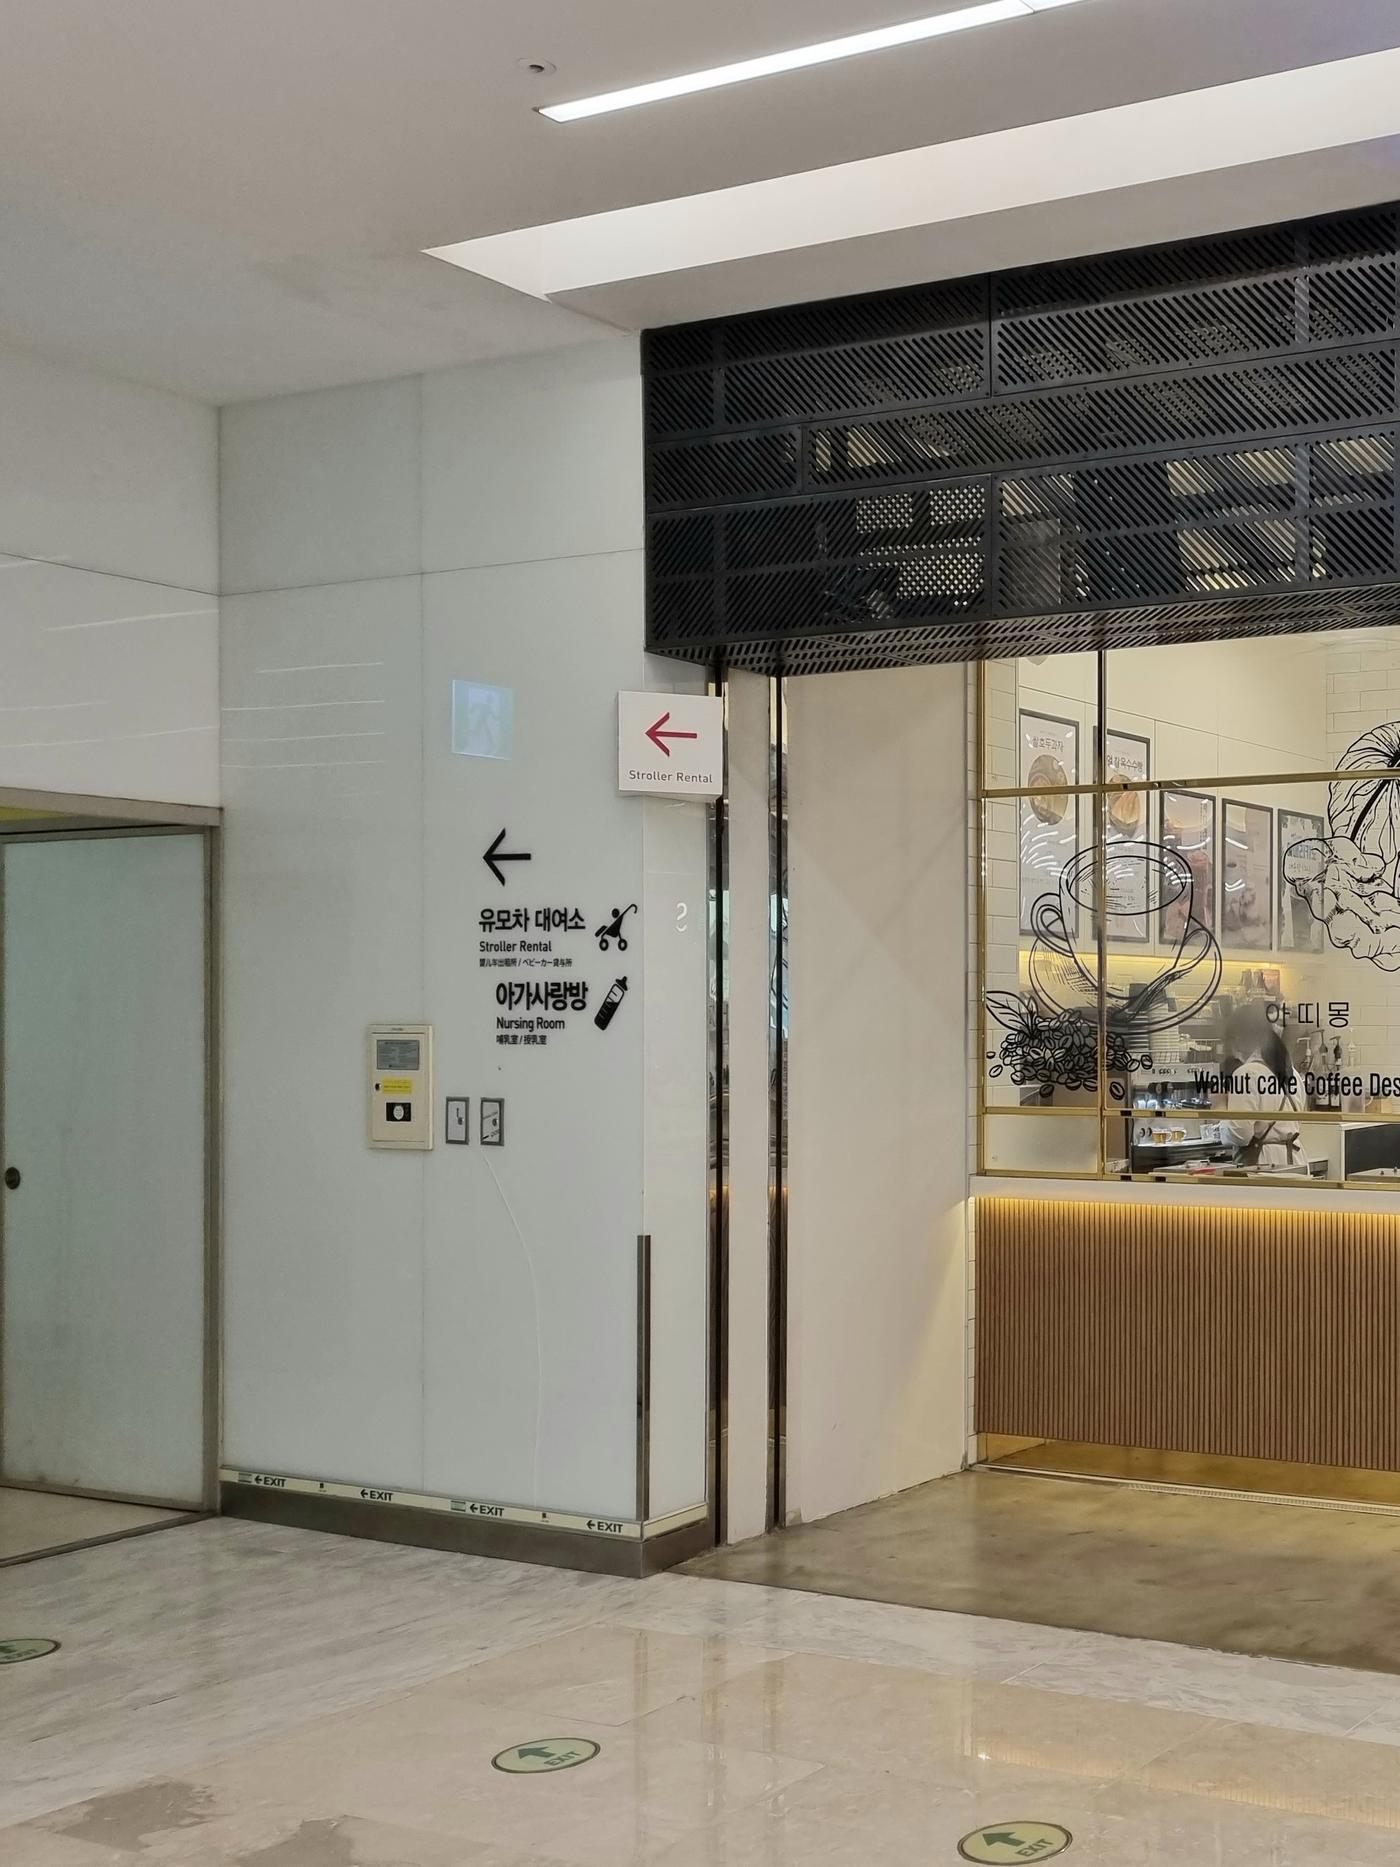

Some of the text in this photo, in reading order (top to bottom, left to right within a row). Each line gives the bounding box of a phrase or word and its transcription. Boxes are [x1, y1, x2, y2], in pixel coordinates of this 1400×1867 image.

[628, 769, 713, 785] Stroller Rental
[478, 906, 586, 933] 유모차 대여소
[479, 940, 552, 952] Stroller Rental
[495, 981, 589, 1011] 아가사랑방
[496, 1017, 565, 1032] Nursing Room
[1194, 1071, 1251, 1095] Walnut
[1257, 1072, 1297, 1096] cake
[1304, 1071, 1362, 1097] Coffee
[263, 1476, 286, 1488] EXIT
[369, 1489, 394, 1502] EXIT
[479, 1504, 505, 1518] EXIT
[596, 1521, 624, 1534] EXIT
[544, 1751, 582, 1767] EXIT
[1015, 1838, 1055, 1857] EXIT
